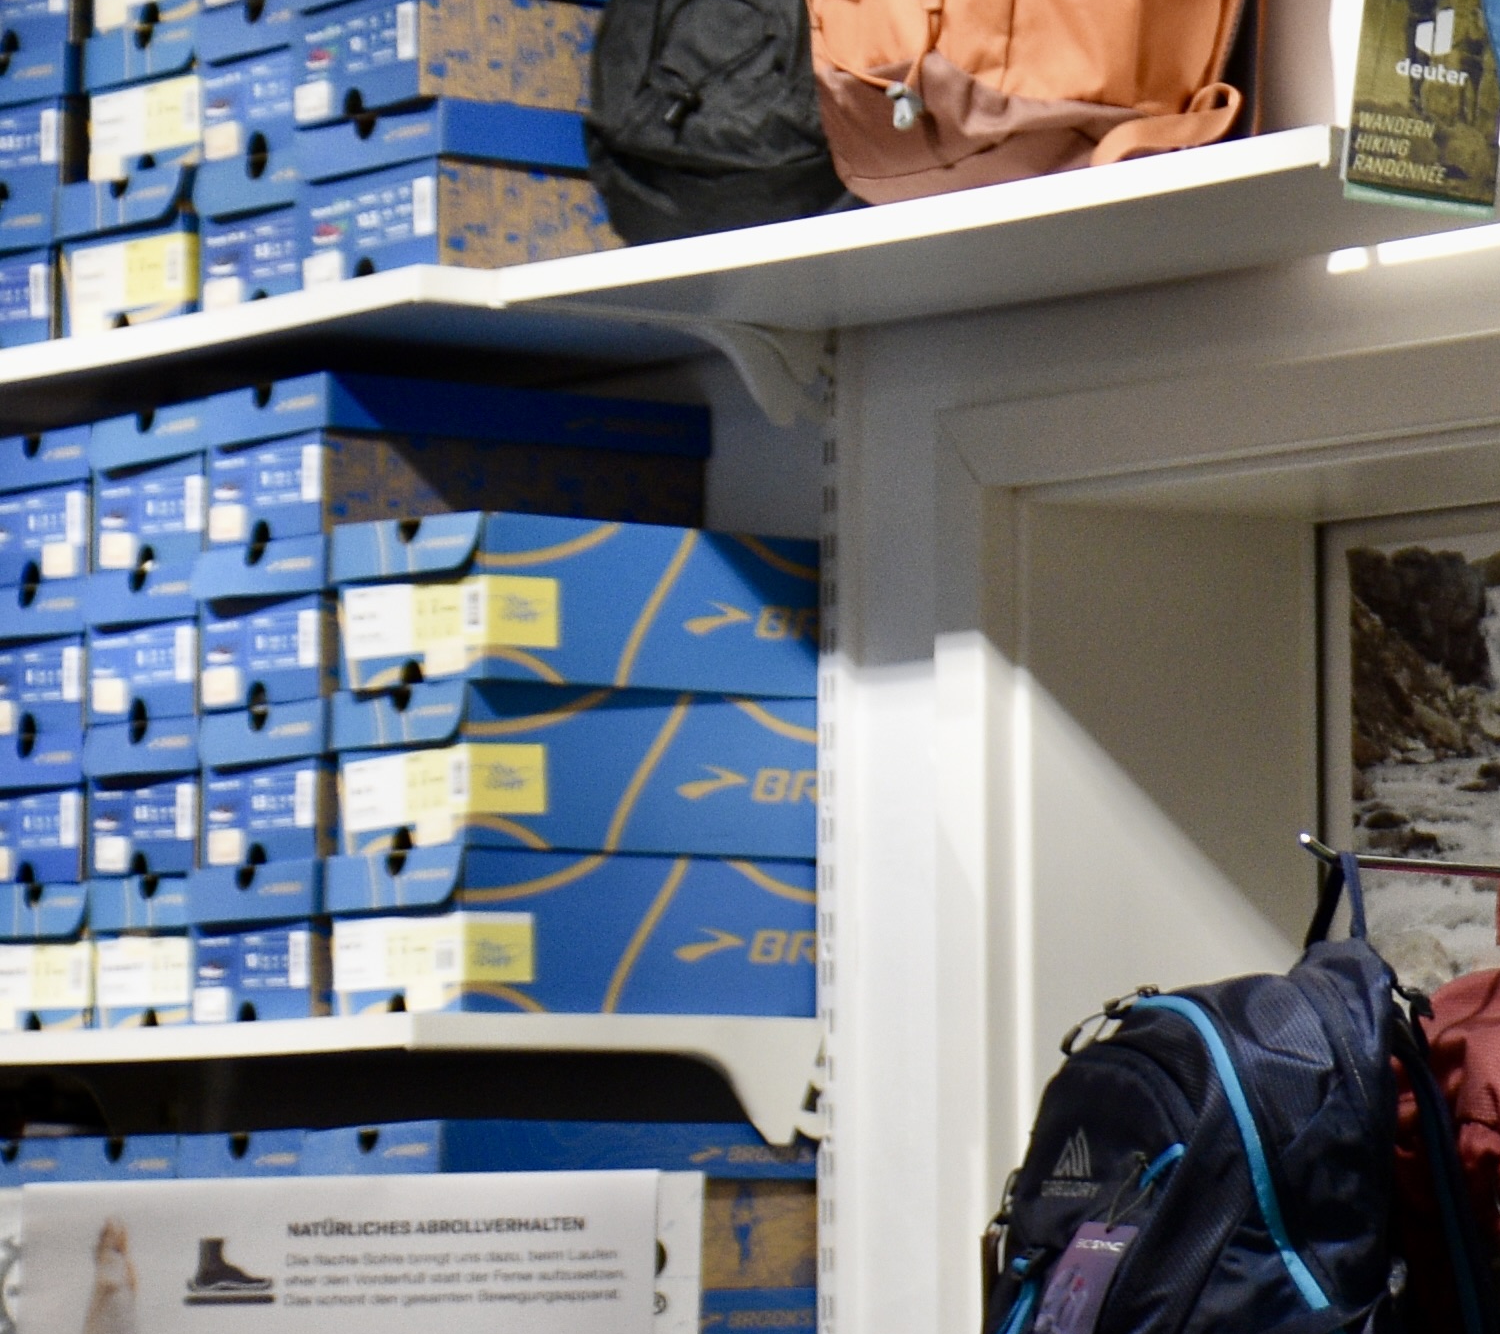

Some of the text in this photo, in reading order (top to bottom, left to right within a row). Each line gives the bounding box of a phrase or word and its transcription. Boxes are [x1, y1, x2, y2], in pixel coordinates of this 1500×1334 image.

[1395, 57, 1469, 87] deuter
[1357, 110, 1436, 140] WANDERN
[1355, 134, 1411, 157] HIKING
[1352, 153, 1448, 185] RANDONNÉE
[287, 1216, 586, 1238] NATÜRLICHES ABROLLVERHALTEN
